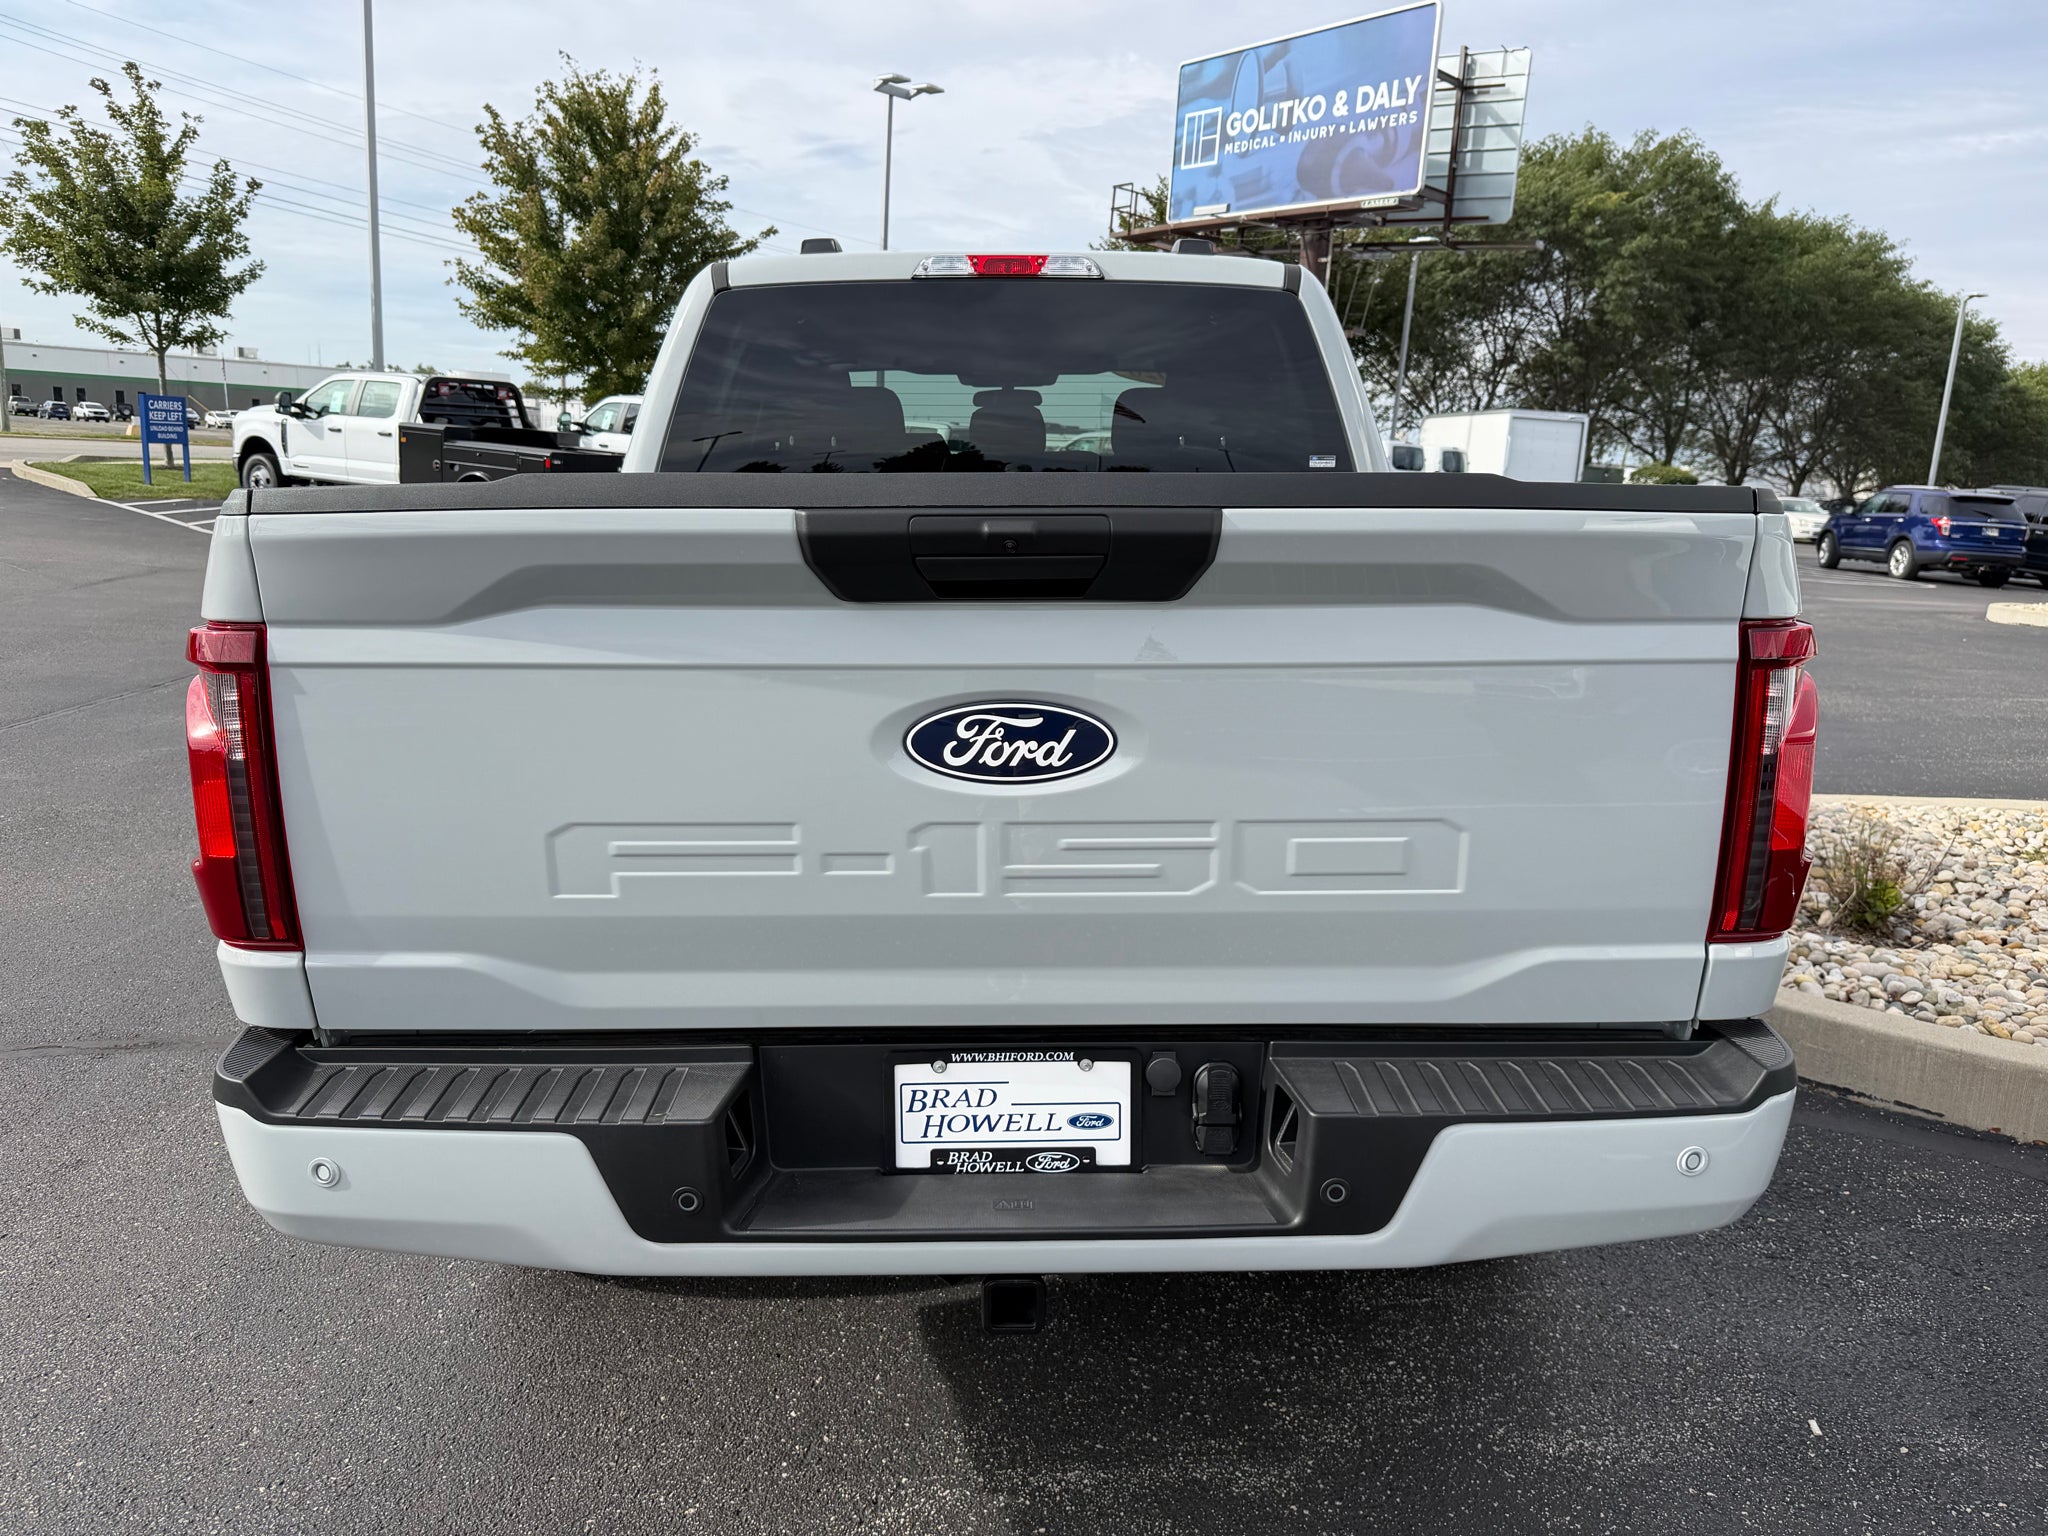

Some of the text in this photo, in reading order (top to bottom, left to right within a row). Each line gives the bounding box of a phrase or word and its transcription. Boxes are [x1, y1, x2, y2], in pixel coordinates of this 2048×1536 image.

[1226, 75, 1423, 137] GOLITKO & DALY
[1224, 110, 1419, 155] MEDICAL INJURY LAWYERS
[148, 400, 182, 410] CARRIERS
[149, 411, 182, 420] KEEP LEFT
[943, 714, 1077, 768] Ford
[544, 819, 1471, 899] F-150
[951, 1051, 1075, 1063] WWW.BHIFORD.COM
[905, 1088, 998, 1113] BRAD
[920, 1112, 1106, 1138] HOWELL Ford
[947, 1151, 993, 1165] BRAD
[954, 1154, 1071, 1175] HOWELL Ford
